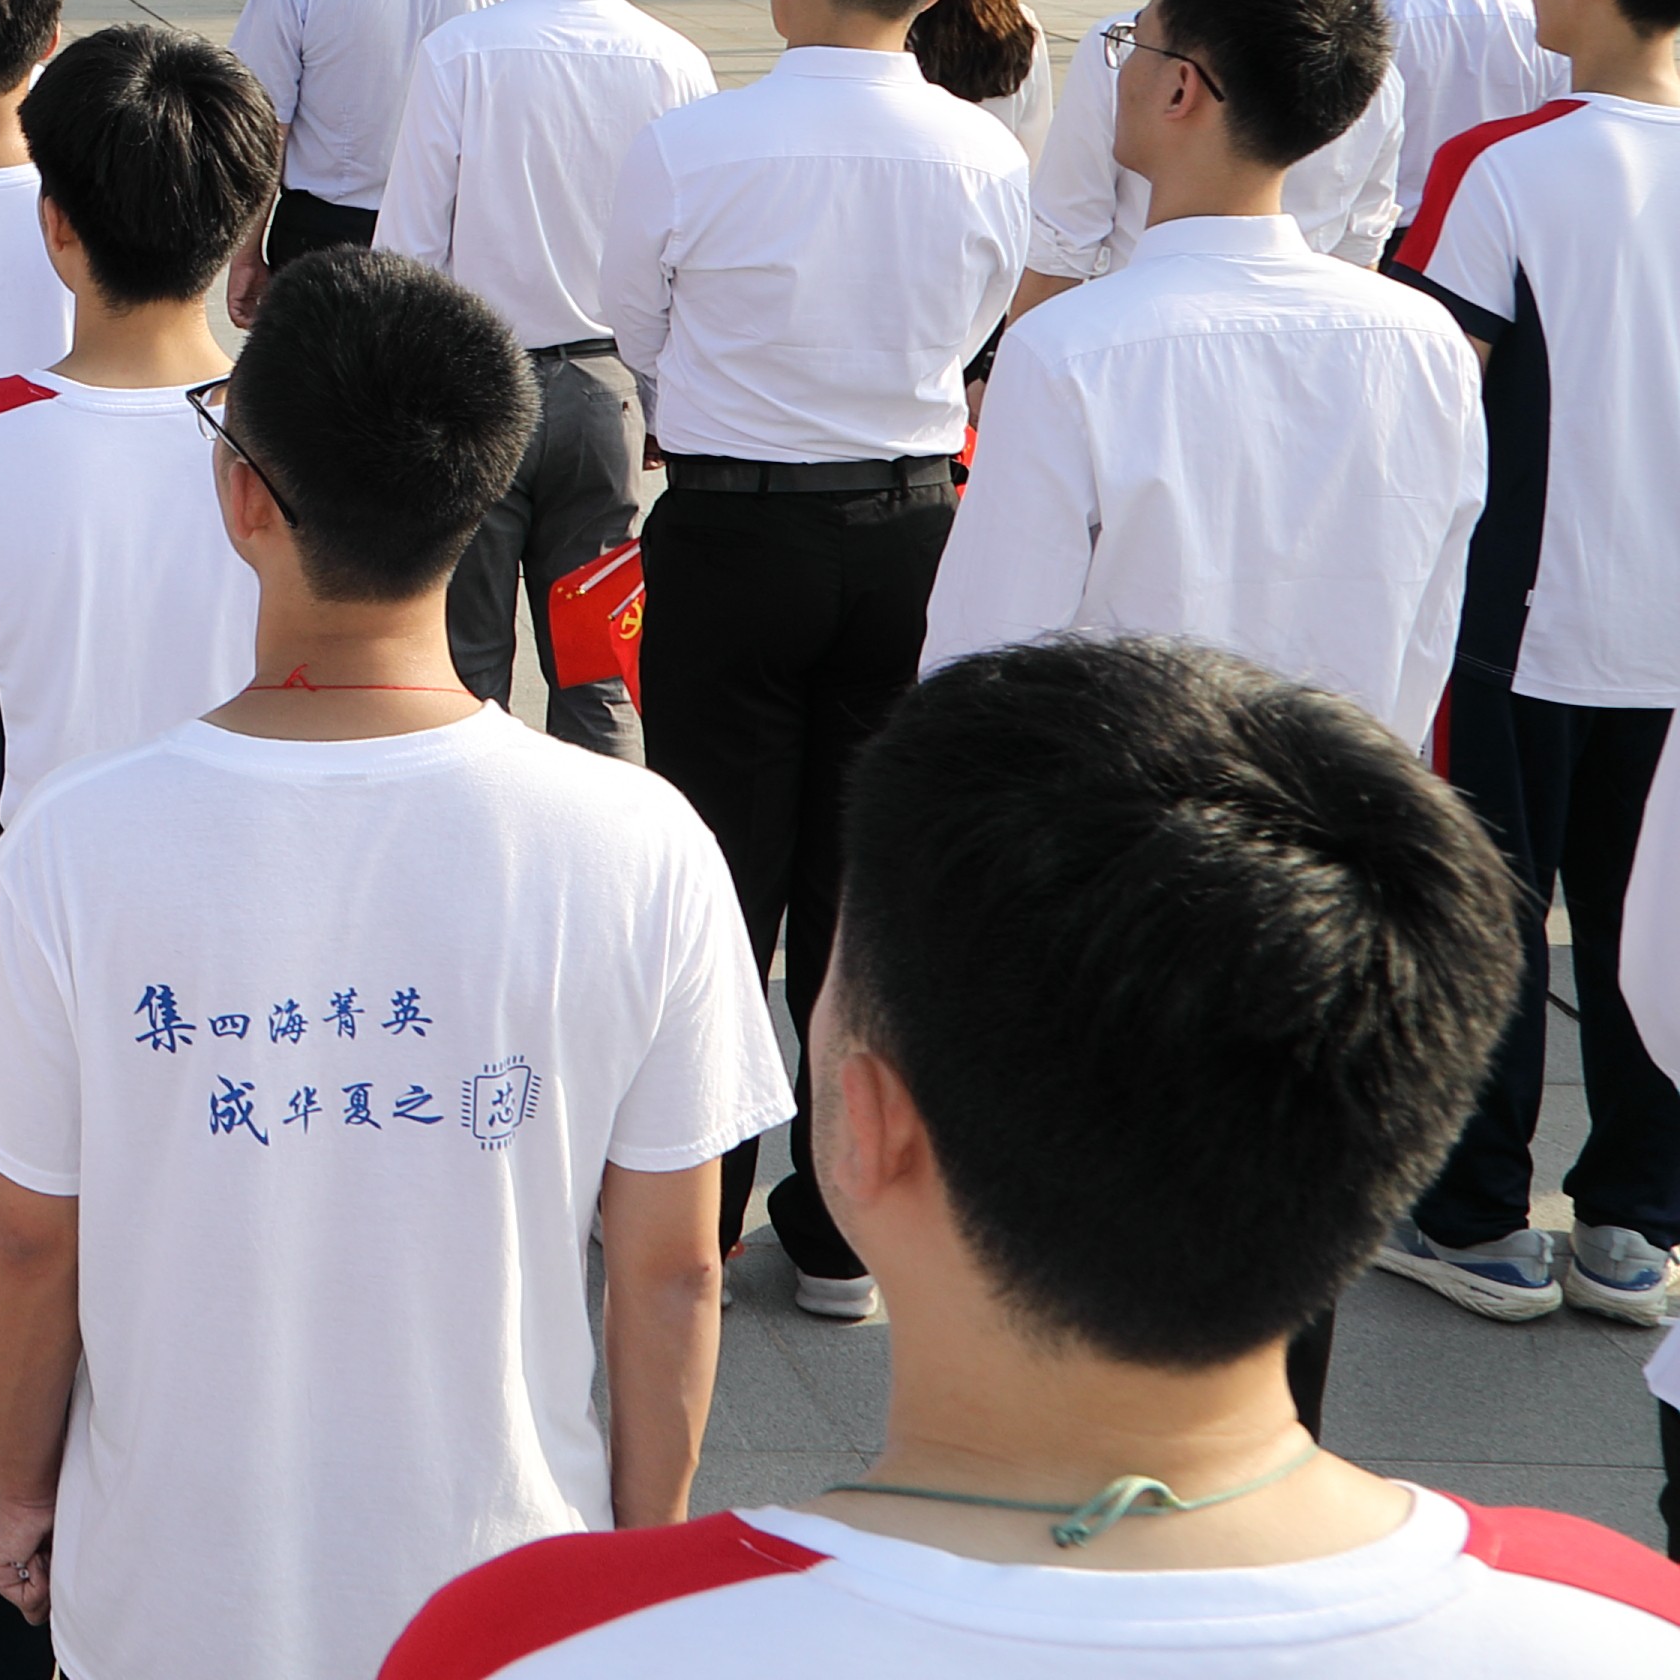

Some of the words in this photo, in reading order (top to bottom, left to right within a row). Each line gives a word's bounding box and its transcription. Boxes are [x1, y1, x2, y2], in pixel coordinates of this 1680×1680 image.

[133, 983, 435, 1054] 集四海菁英
